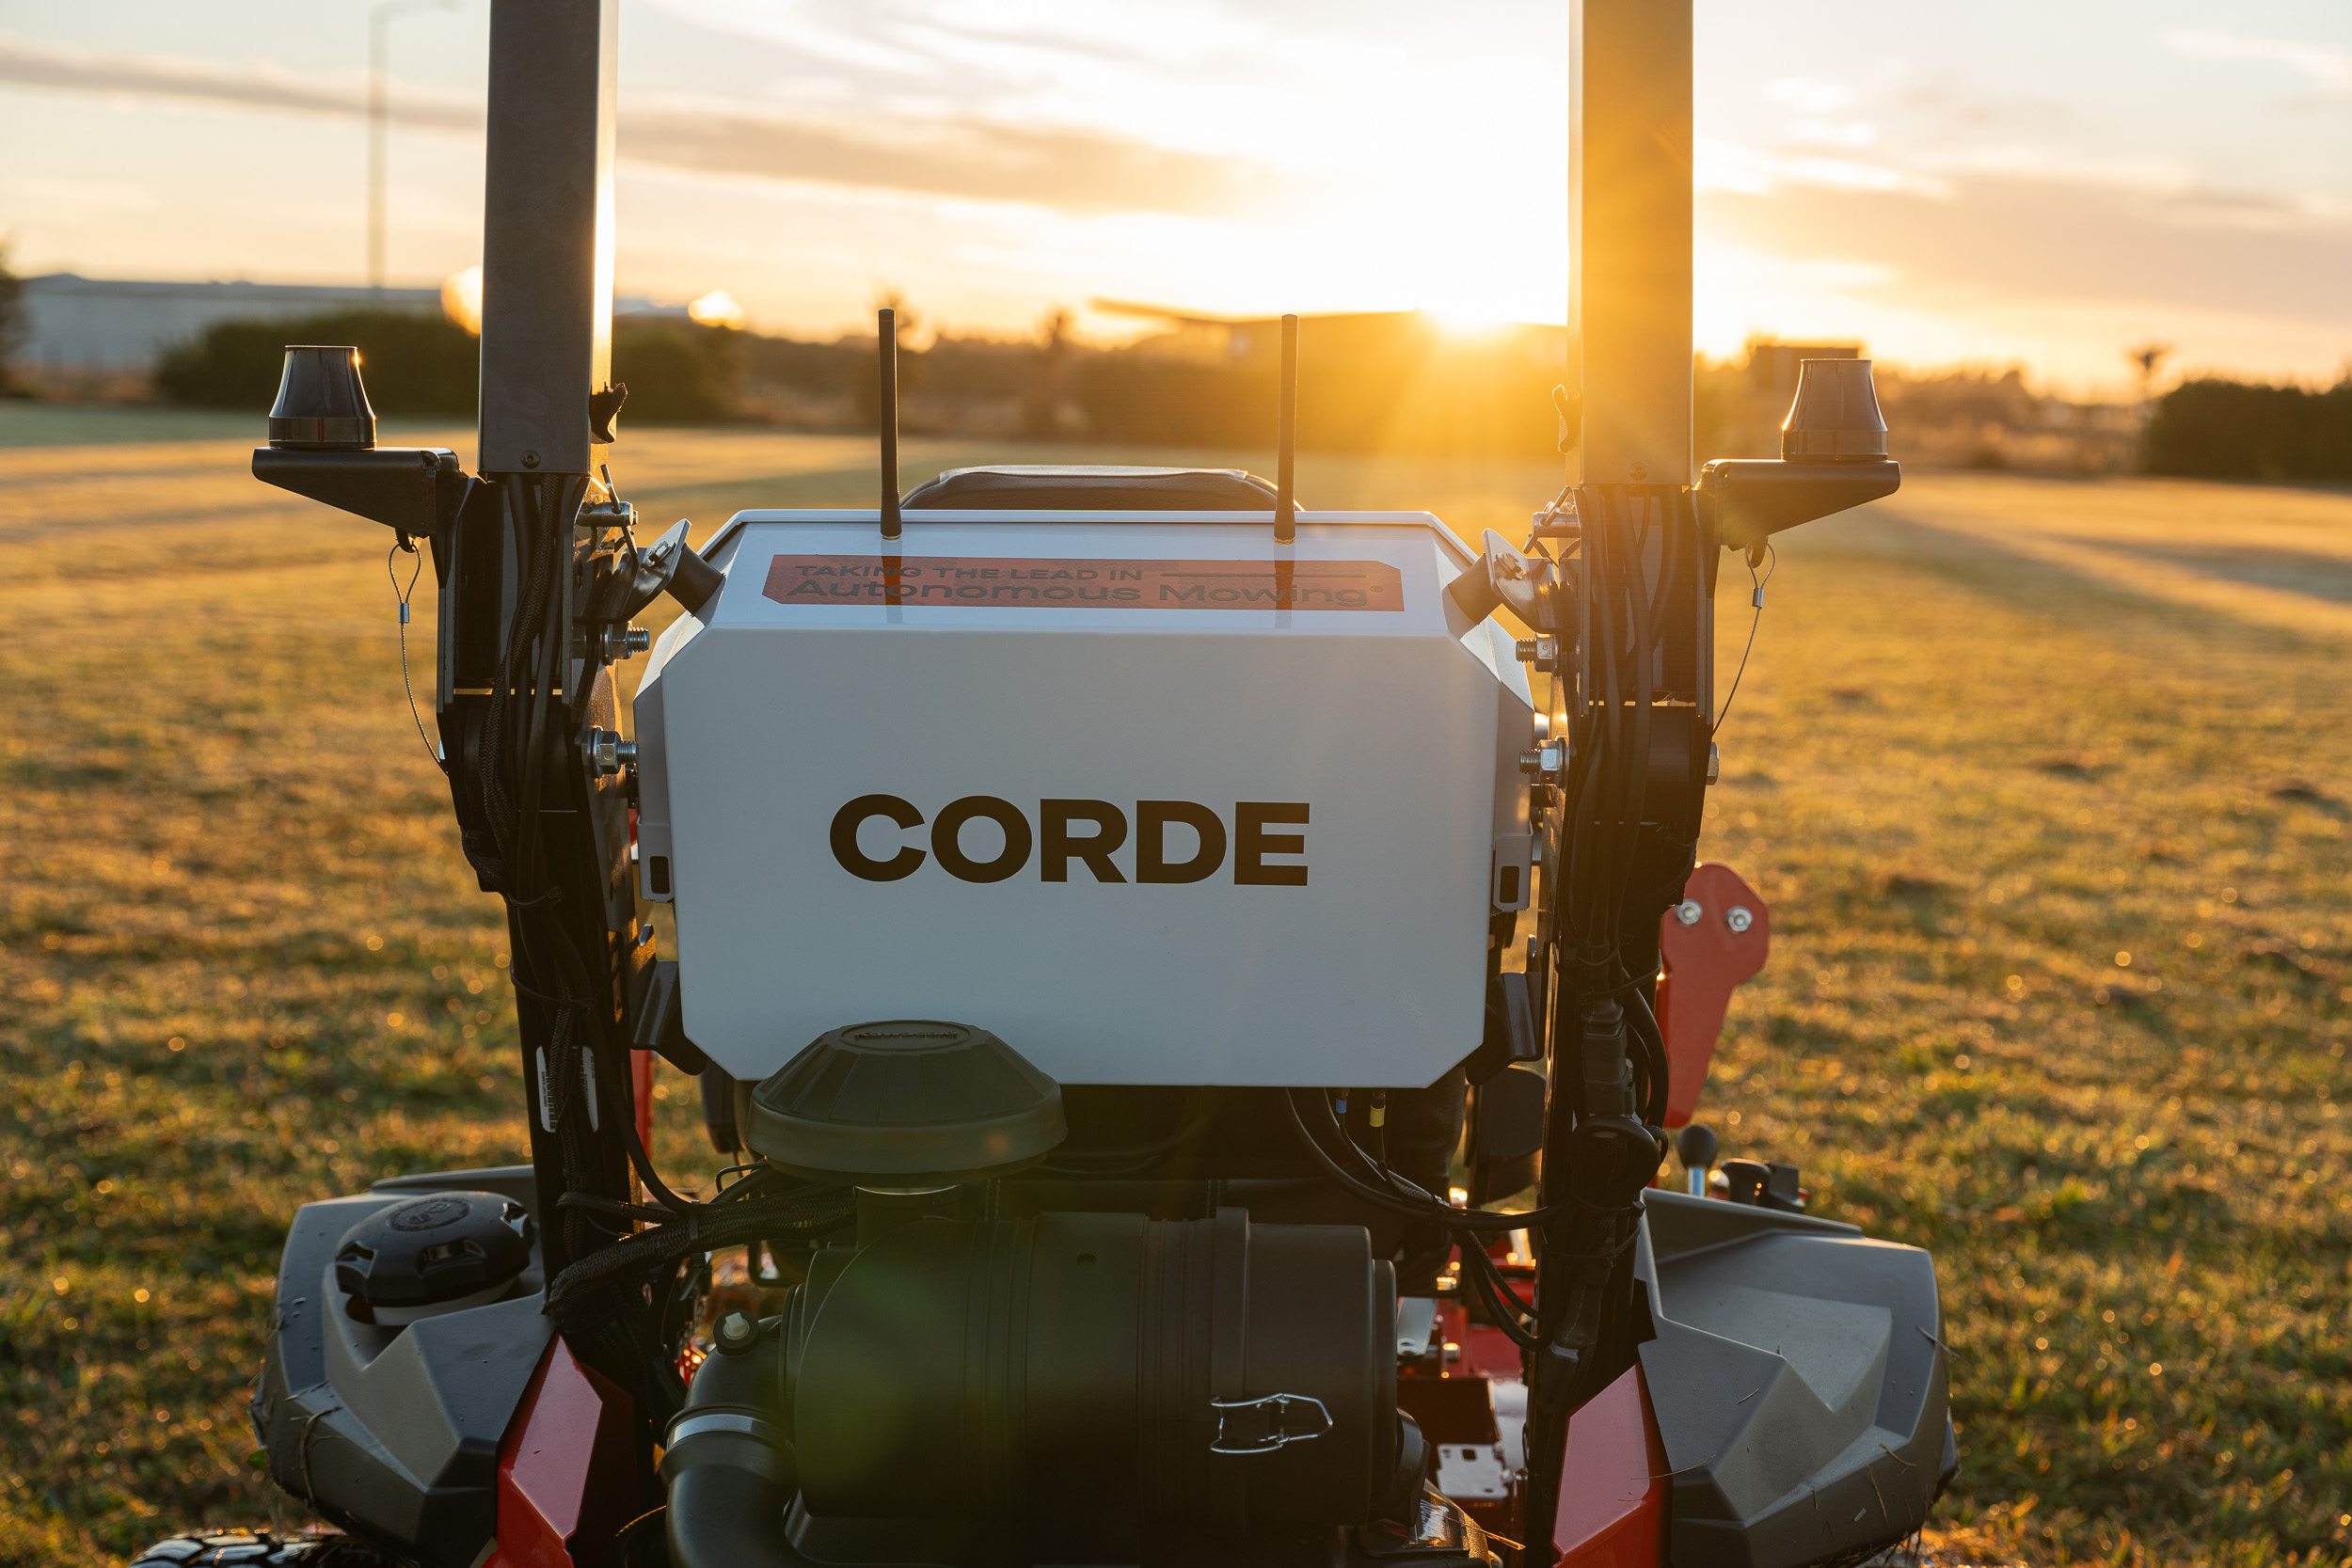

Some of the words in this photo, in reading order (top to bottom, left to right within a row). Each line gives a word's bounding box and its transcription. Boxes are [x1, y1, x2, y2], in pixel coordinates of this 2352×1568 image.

[795, 565, 921, 577] TAKING
[933, 567, 999, 578] THE
[1010, 569, 1098, 579] LEAD
[1109, 569, 1142, 580] IN
[787, 579, 1141, 600] Autonomous
[830, 793, 1311, 886] CORDE
